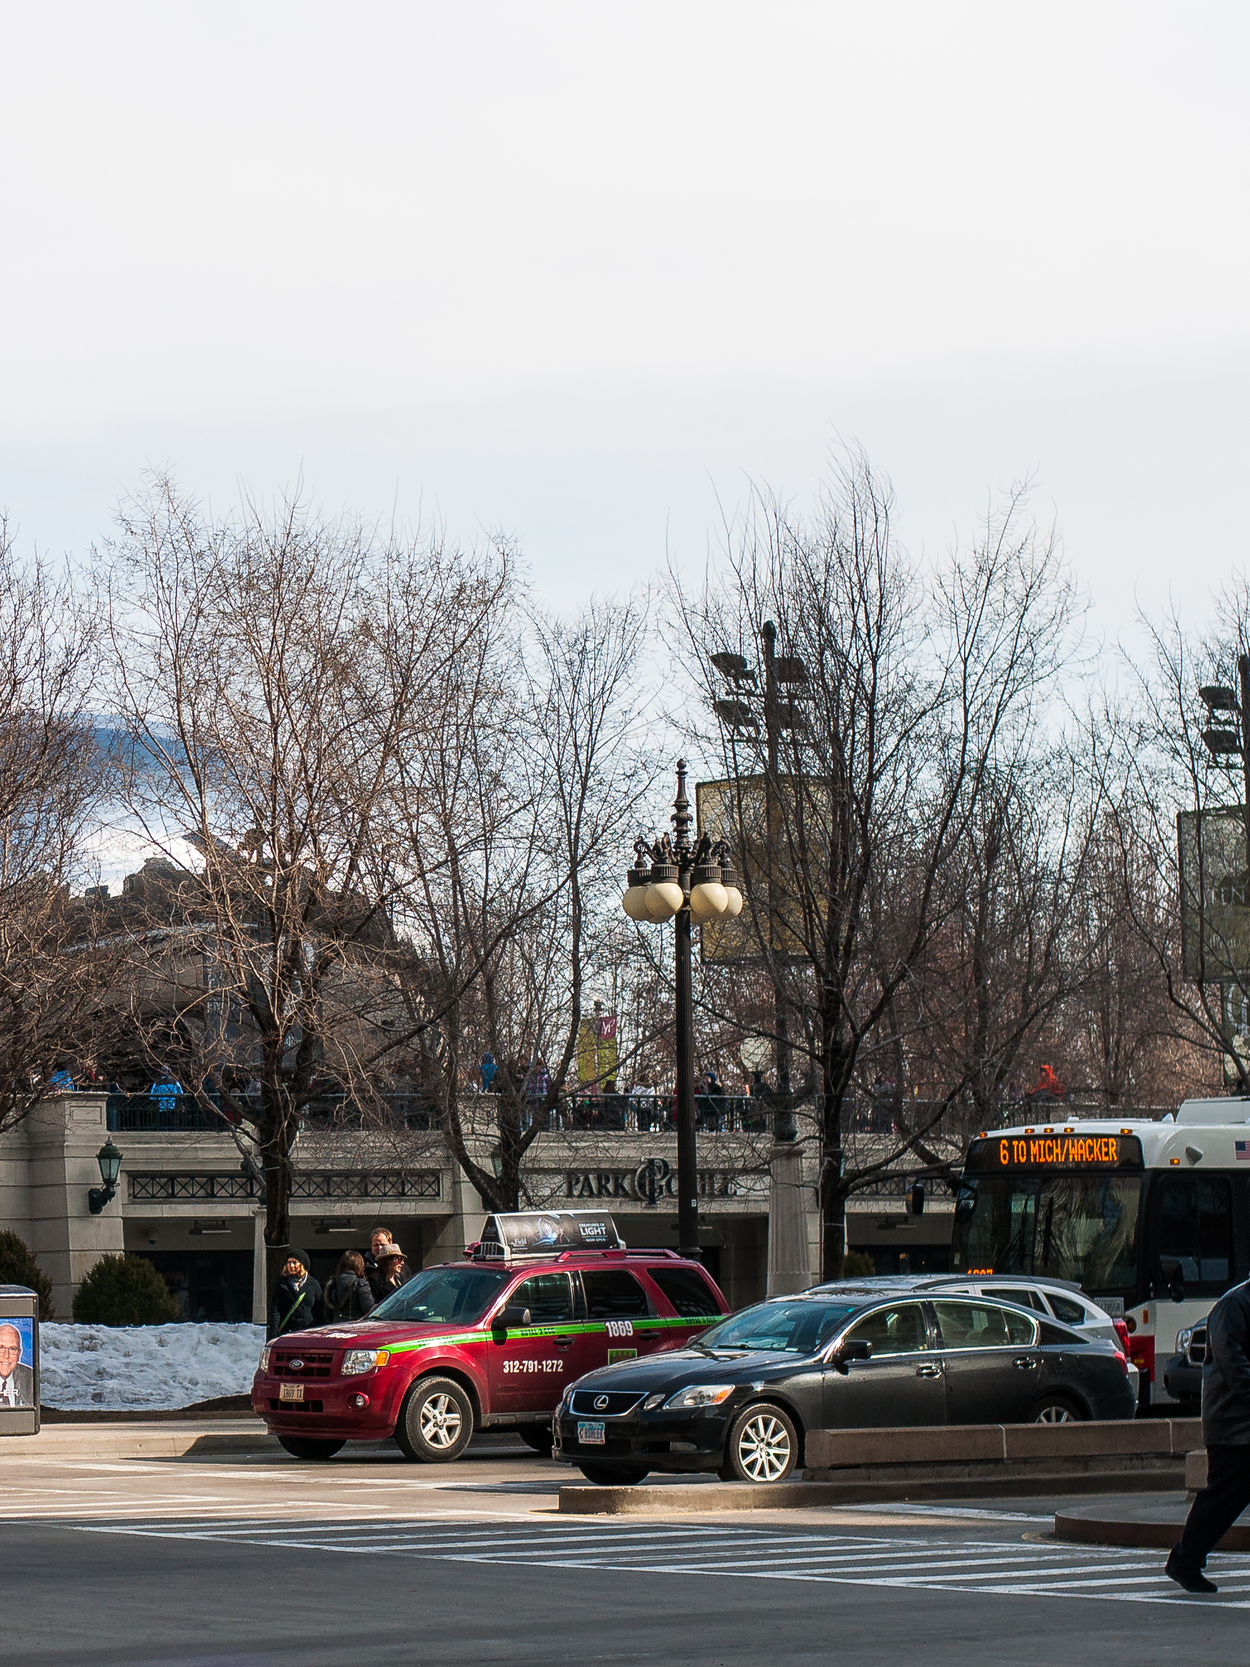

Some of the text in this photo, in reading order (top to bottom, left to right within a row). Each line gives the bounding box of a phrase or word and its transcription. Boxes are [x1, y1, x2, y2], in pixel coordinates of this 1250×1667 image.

[1000, 1138, 1118, 1165] 6 TO MICH/WACKER
[567, 1174, 628, 1197] PARK
[580, 1226, 606, 1236] LIGHT
[605, 1320, 633, 1338] 1869
[503, 1360, 564, 1373] 312-791-1272
